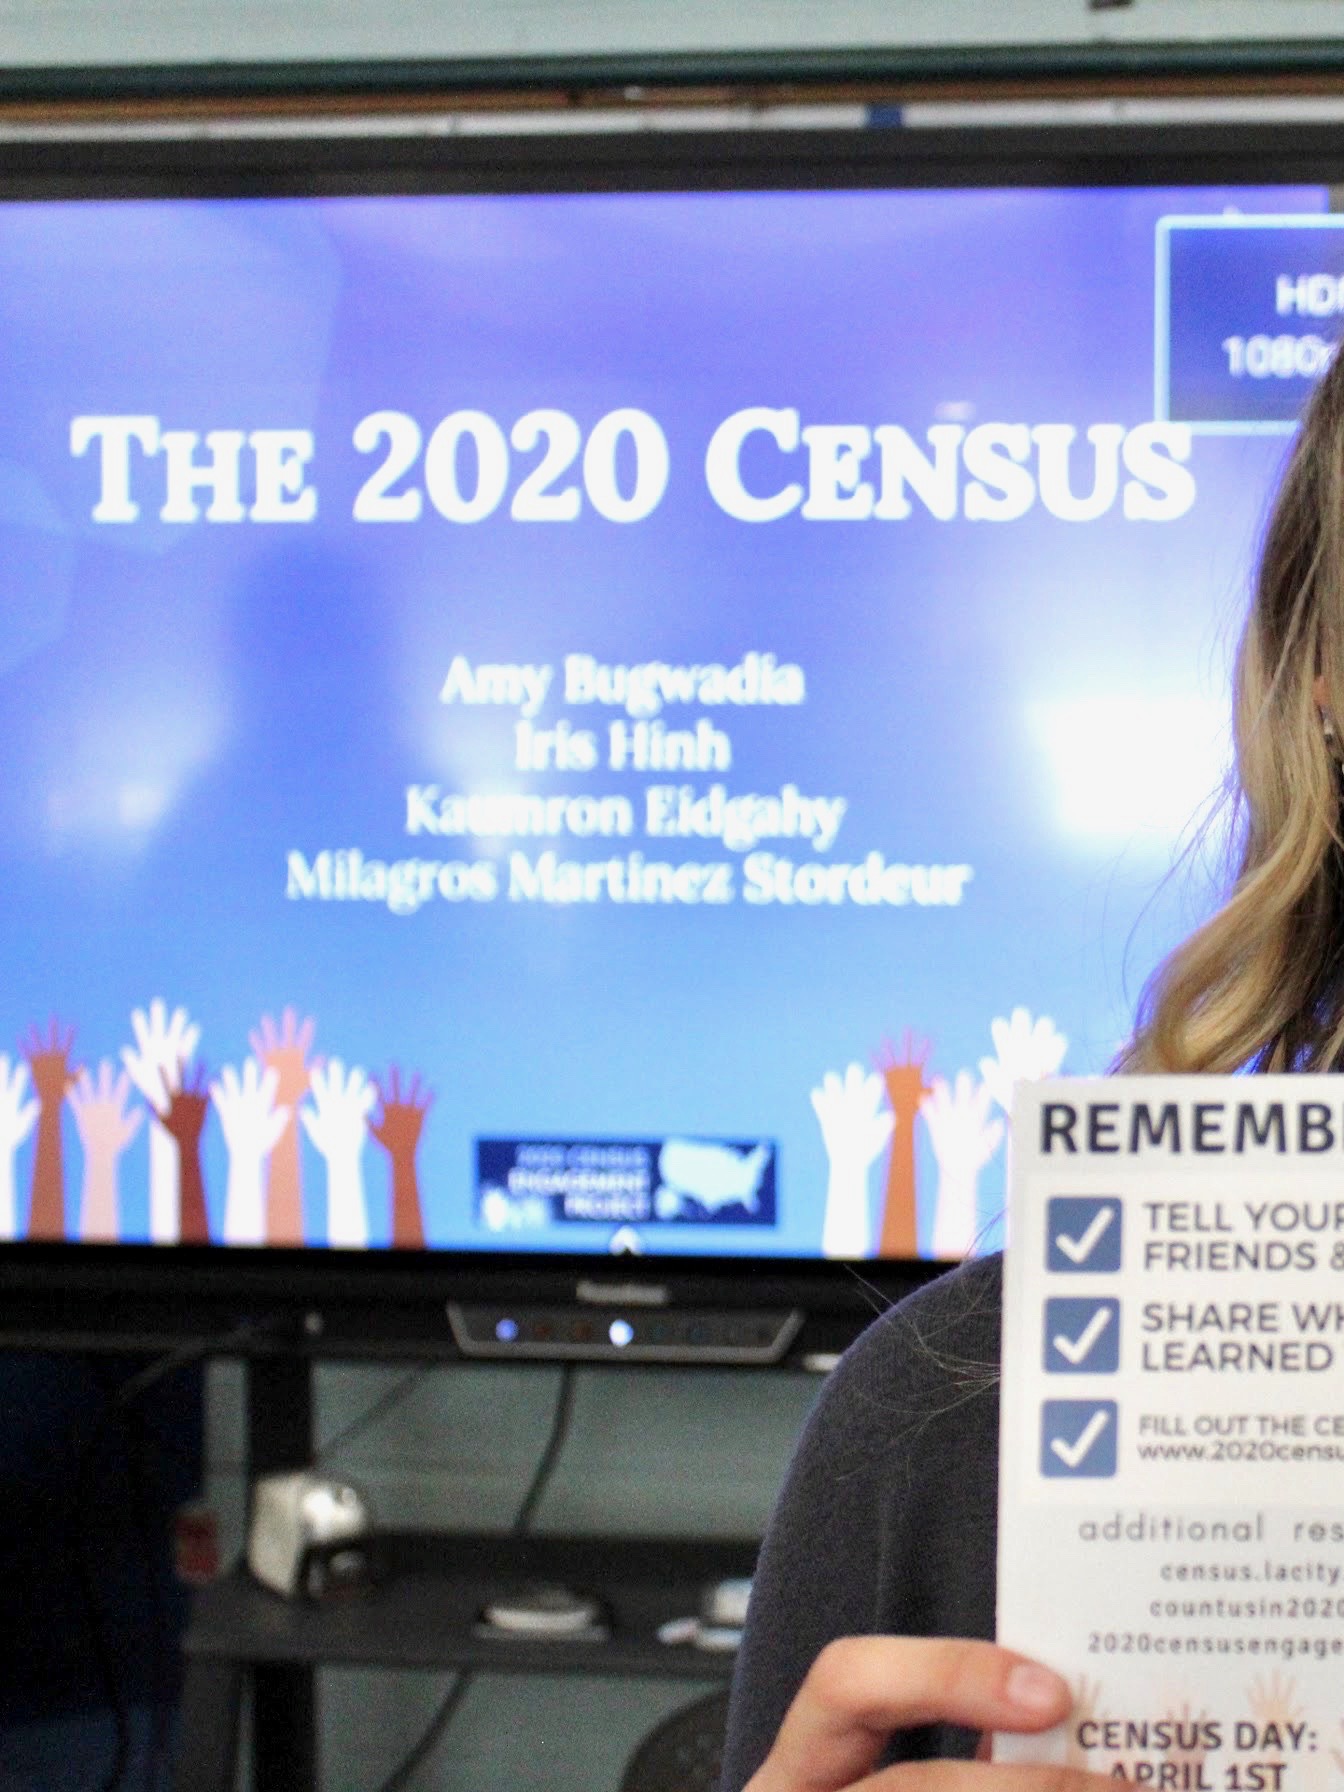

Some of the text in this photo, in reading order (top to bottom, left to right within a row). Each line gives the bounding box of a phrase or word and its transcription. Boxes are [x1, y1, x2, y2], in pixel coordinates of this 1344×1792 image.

[1222, 334, 1338, 379] 1080
[69, 407, 1196, 524] THE 2020 CENSUS
[440, 651, 806, 718] Amy Bugwadia
[515, 717, 732, 771] Iris Hinh
[286, 848, 975, 915] Milagros Martinez Stordeur
[1144, 1202, 1234, 1233] TELL
[1144, 1241, 1317, 1272] FRIENDS
[1142, 1303, 1279, 1333] SHARE
[1142, 1341, 1335, 1373] LEARNED
[1139, 1415, 1187, 1436] FILL
[1193, 1415, 1250, 1436] OUT
[1256, 1415, 1306, 1436] THE
[1079, 1511, 1265, 1542] additional
[1077, 1721, 1318, 1751] CENSUS DAY:
[1110, 1761, 1288, 1792] APRIL 1ST
